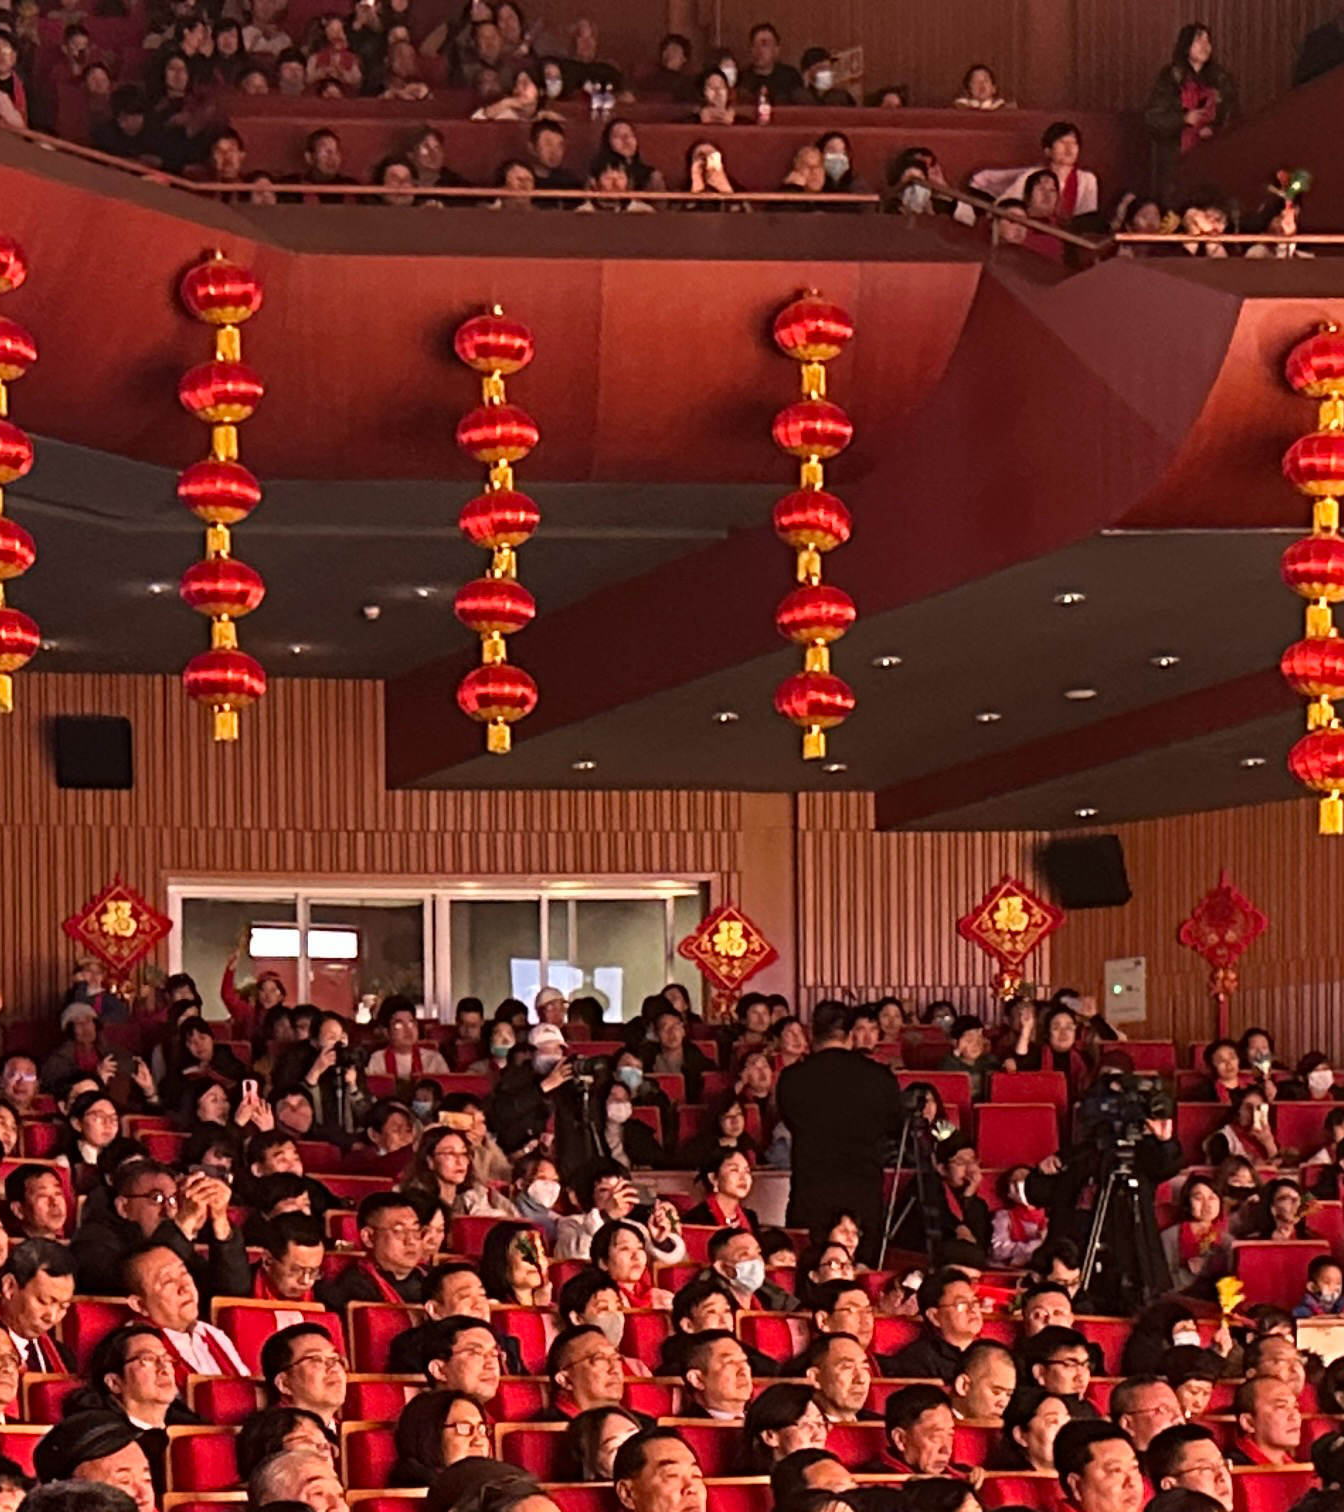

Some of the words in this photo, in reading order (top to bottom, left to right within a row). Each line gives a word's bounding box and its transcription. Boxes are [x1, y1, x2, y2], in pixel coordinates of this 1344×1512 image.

[100, 900, 137, 937] 福
[992, 896, 1029, 932] 福
[713, 920, 747, 957] 福
